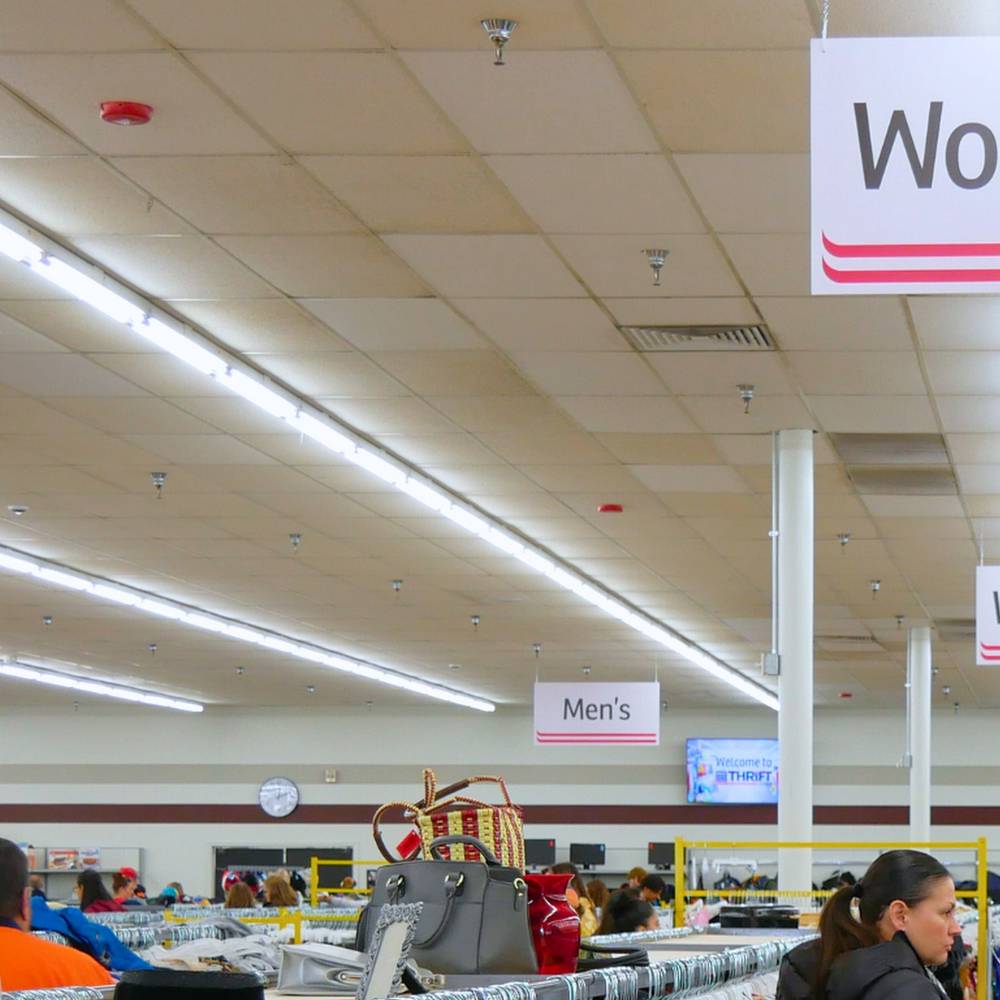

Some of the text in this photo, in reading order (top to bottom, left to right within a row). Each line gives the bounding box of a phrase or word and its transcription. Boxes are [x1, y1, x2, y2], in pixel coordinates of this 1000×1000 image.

[563, 696, 631, 721] Men's
[715, 757, 773, 768] Welcome to
[728, 770, 773, 782] THRIFT
